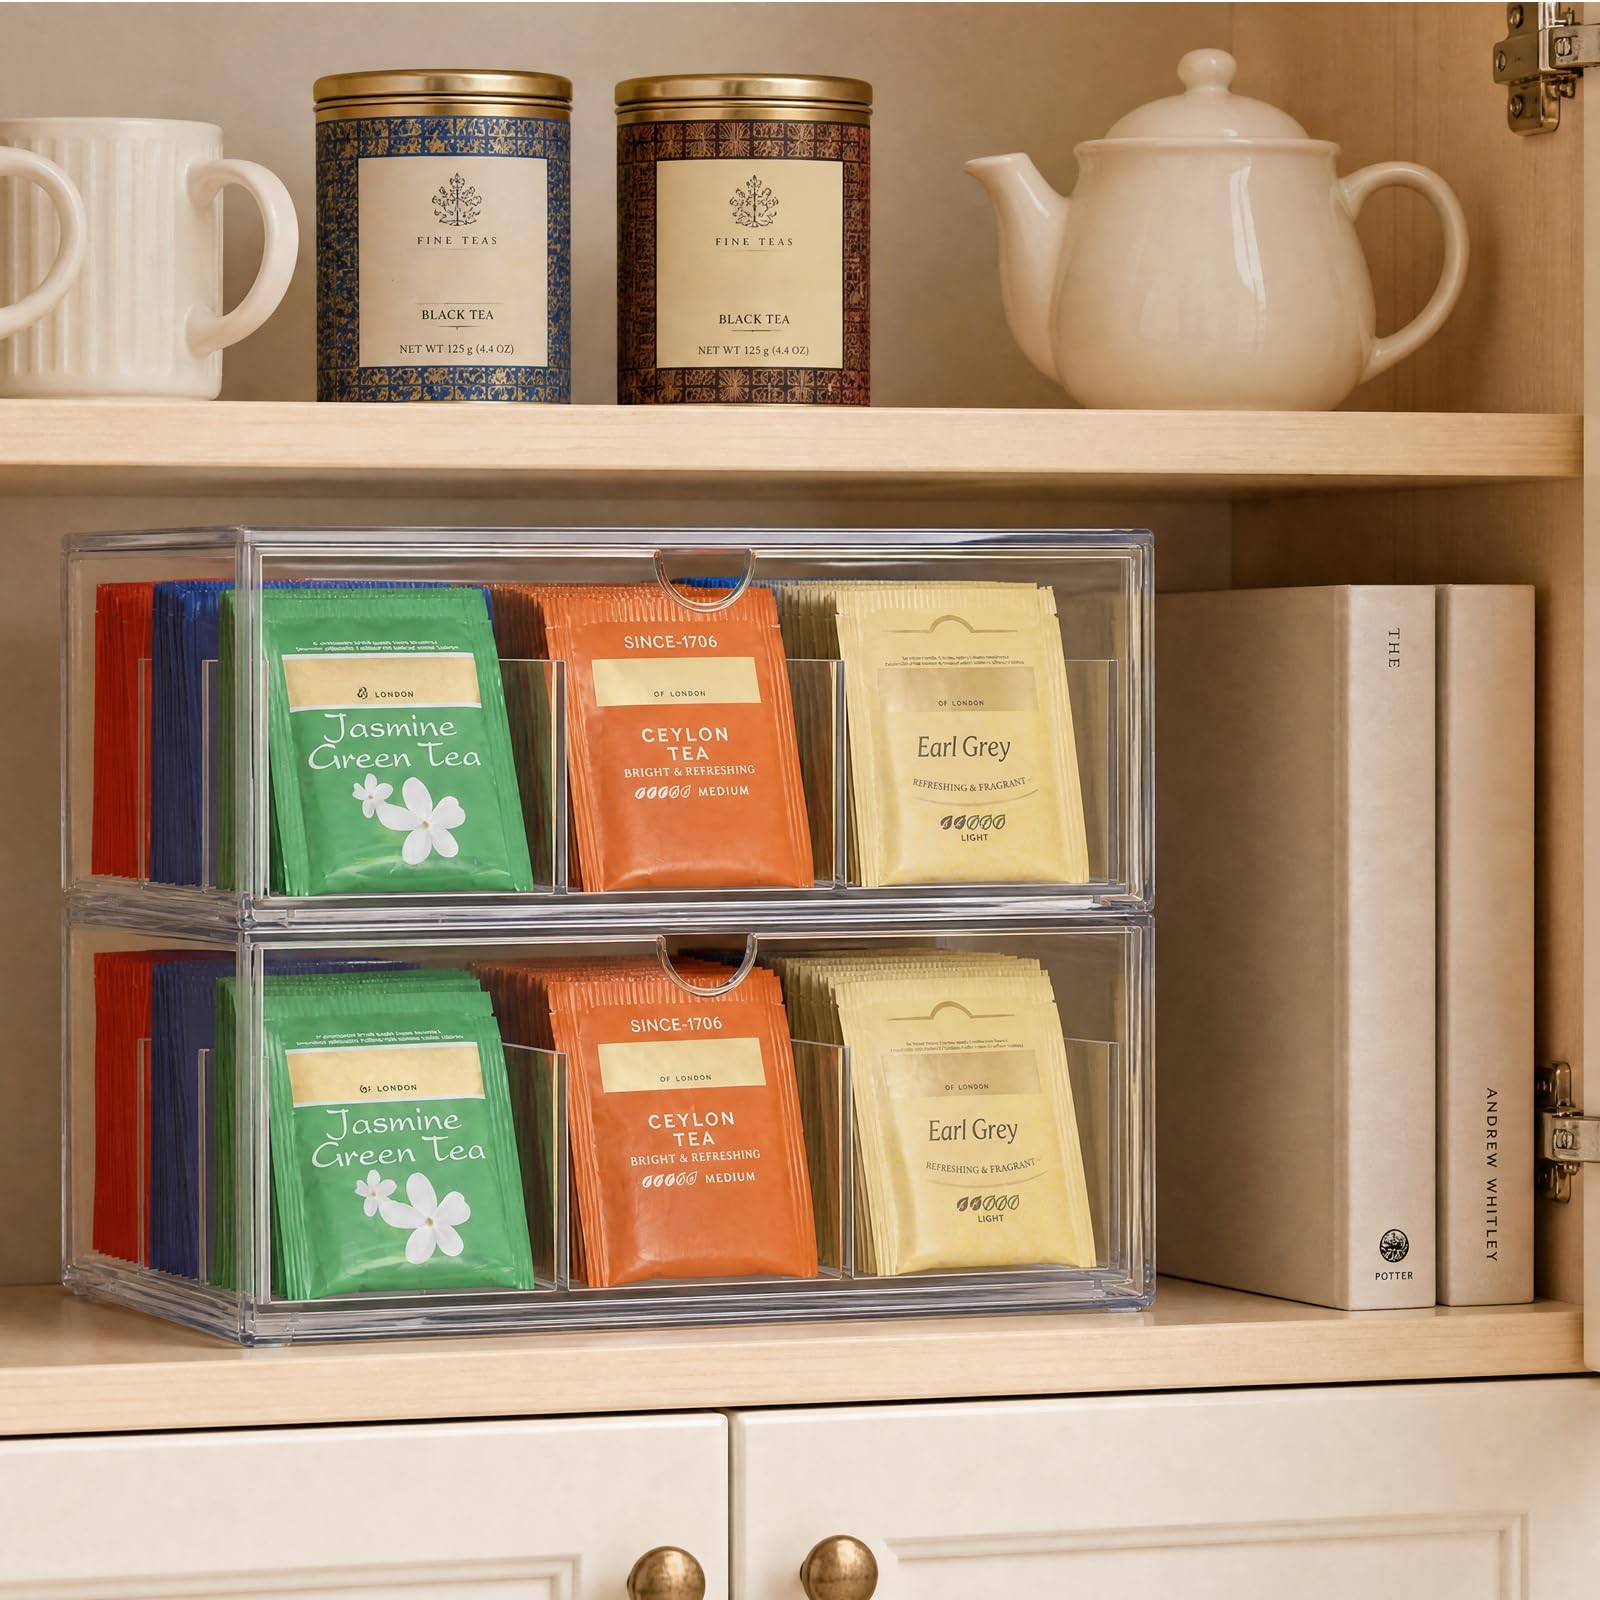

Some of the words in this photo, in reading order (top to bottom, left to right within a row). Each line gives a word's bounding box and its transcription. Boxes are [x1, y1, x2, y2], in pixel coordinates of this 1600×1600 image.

[417, 236, 452, 245] FINE
[462, 236, 497, 245] TEAS
[715, 238, 749, 246] FINE
[759, 238, 793, 246] TEAS
[422, 310, 465, 320] BLACK
[469, 310, 494, 320] TEA
[719, 314, 762, 324] BLACK
[766, 314, 790, 324] TEA
[400, 345, 422, 354] NET
[425, 345, 444, 353] WT
[448, 345, 465, 353] 125
[467, 346, 473, 356] g
[476, 344, 494, 355] (4.4
[496, 344, 514, 355] OZ)
[699, 347, 720, 355] NET
[723, 347, 740, 355] WT
[745, 347, 760, 355] 125
[763, 348, 769, 357] g
[772, 346, 789, 356] (4.4
[792, 346, 809, 356] OZ)
[624, 635, 718, 649] SINCE-1706
[1389, 628, 1400, 667] THE
[323, 713, 457, 744] Jasmine
[641, 727, 728, 743] CEYLON
[308, 743, 412, 770] Green
[417, 742, 481, 767] Tea
[667, 746, 709, 760] TEA
[918, 736, 957, 757] Earl
[963, 736, 1011, 762] Grey
[624, 768, 670, 778] BRIGHT
[674, 768, 682, 776] &
[686, 765, 755, 776] REFRESHING
[698, 786, 749, 796] MEDIUM
[913, 778, 968, 791] REFRESHING
[969, 784, 976, 792] &
[979, 777, 1026, 791] FRAGRANT
[631, 1017, 722, 1033] SINCE-1706
[377, 1084, 417, 1092] LONDON
[326, 1108, 462, 1141] Jasmine
[648, 1111, 735, 1129] CEYLON
[929, 1119, 967, 1141] Earl
[972, 1118, 1018, 1144] Grey
[1487, 1088, 1497, 1168] ANDREW
[673, 1132, 715, 1147] TEA
[311, 1141, 416, 1168] Green
[422, 1135, 486, 1161] Tea
[631, 1154, 676, 1167] BRIGHT
[679, 1154, 688, 1163] &
[692, 1149, 761, 1162] REFRESHING
[926, 1162, 979, 1174] REFRESHING
[990, 1158, 1036, 1173] FRAGRANT
[705, 1172, 756, 1184] MEDIUM
[1487, 1178, 1497, 1261] WHITLEY
[1375, 1272, 1413, 1280] POTTER
